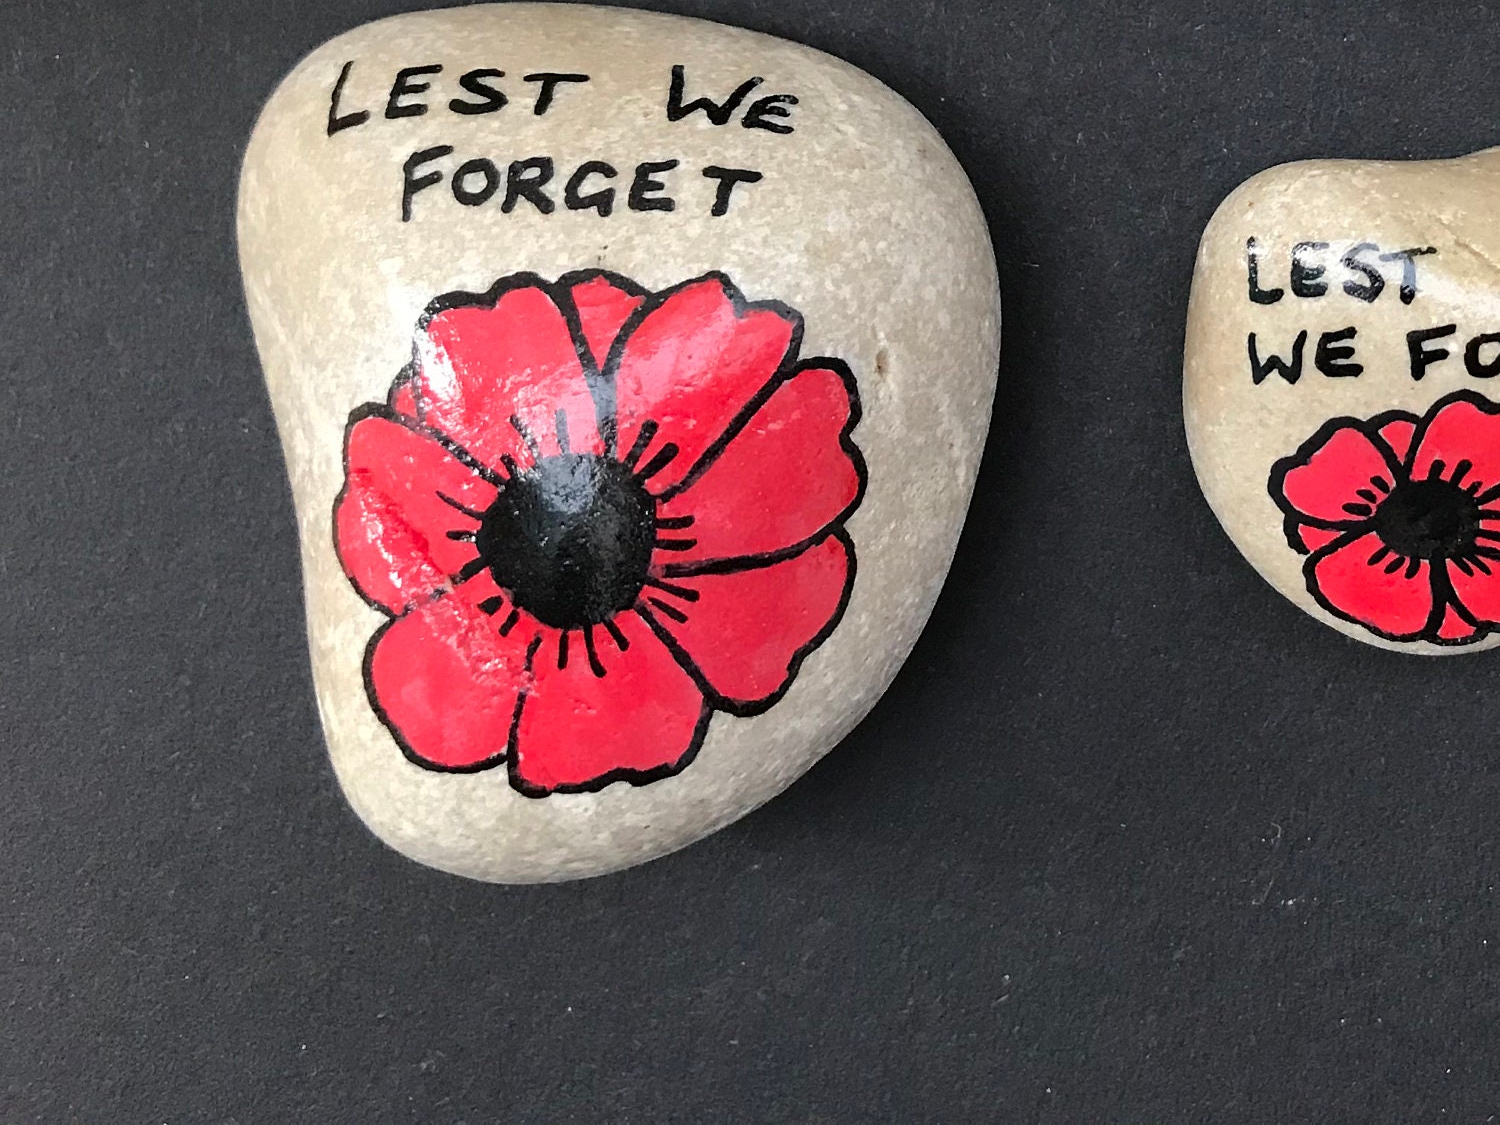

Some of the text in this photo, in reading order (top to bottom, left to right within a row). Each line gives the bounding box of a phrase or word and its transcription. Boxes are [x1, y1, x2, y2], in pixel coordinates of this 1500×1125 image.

[327, 60, 800, 137] LEST WE
[401, 144, 764, 223] FORGET
[1246, 235, 1438, 306] LEST
[1247, 325, 1365, 386] WE
